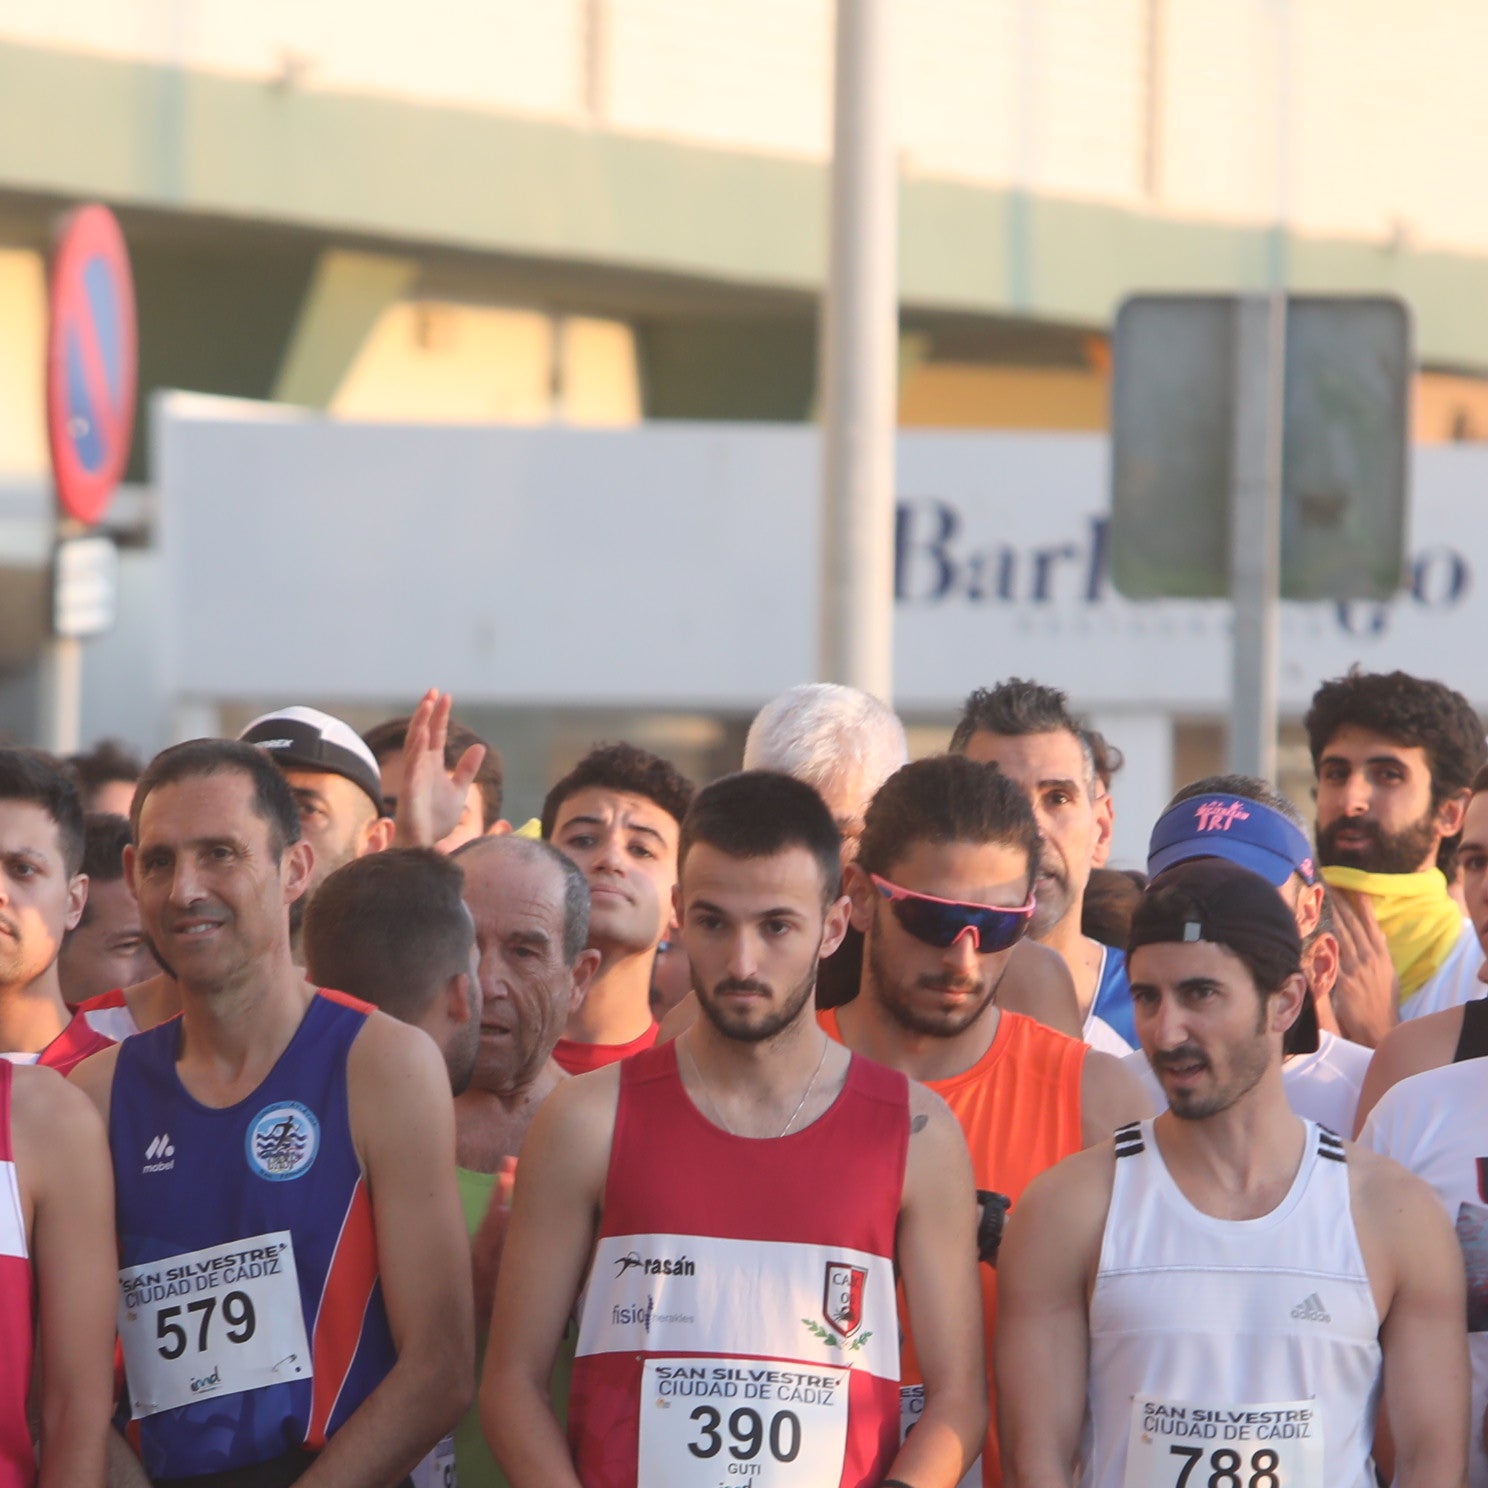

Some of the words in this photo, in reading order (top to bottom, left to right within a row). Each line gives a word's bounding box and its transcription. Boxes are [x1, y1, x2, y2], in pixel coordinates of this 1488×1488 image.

[122, 1273, 160, 1293] SAN
[167, 1245, 278, 1281] SILVESTRE
[644, 1255, 695, 1276] rasán
[125, 1279, 191, 1309] CIUDAD
[196, 1271, 219, 1291] DE
[223, 1258, 282, 1284] CADIZ
[157, 1291, 256, 1360] 579
[658, 1367, 705, 1379] SAN
[712, 1367, 835, 1388] SILVESTRE
[659, 1380, 738, 1398] CIUDAD
[744, 1383, 771, 1399] DE
[777, 1385, 834, 1406] CADIZ
[1143, 1402, 1186, 1419] SAN
[1192, 1410, 1311, 1424] SILVESTRE
[687, 1405, 801, 1462] 390
[1144, 1415, 1217, 1439] CIUDAD
[1224, 1424, 1252, 1440] DE
[1257, 1423, 1311, 1440] CADIZ
[728, 1463, 761, 1475] GUTI
